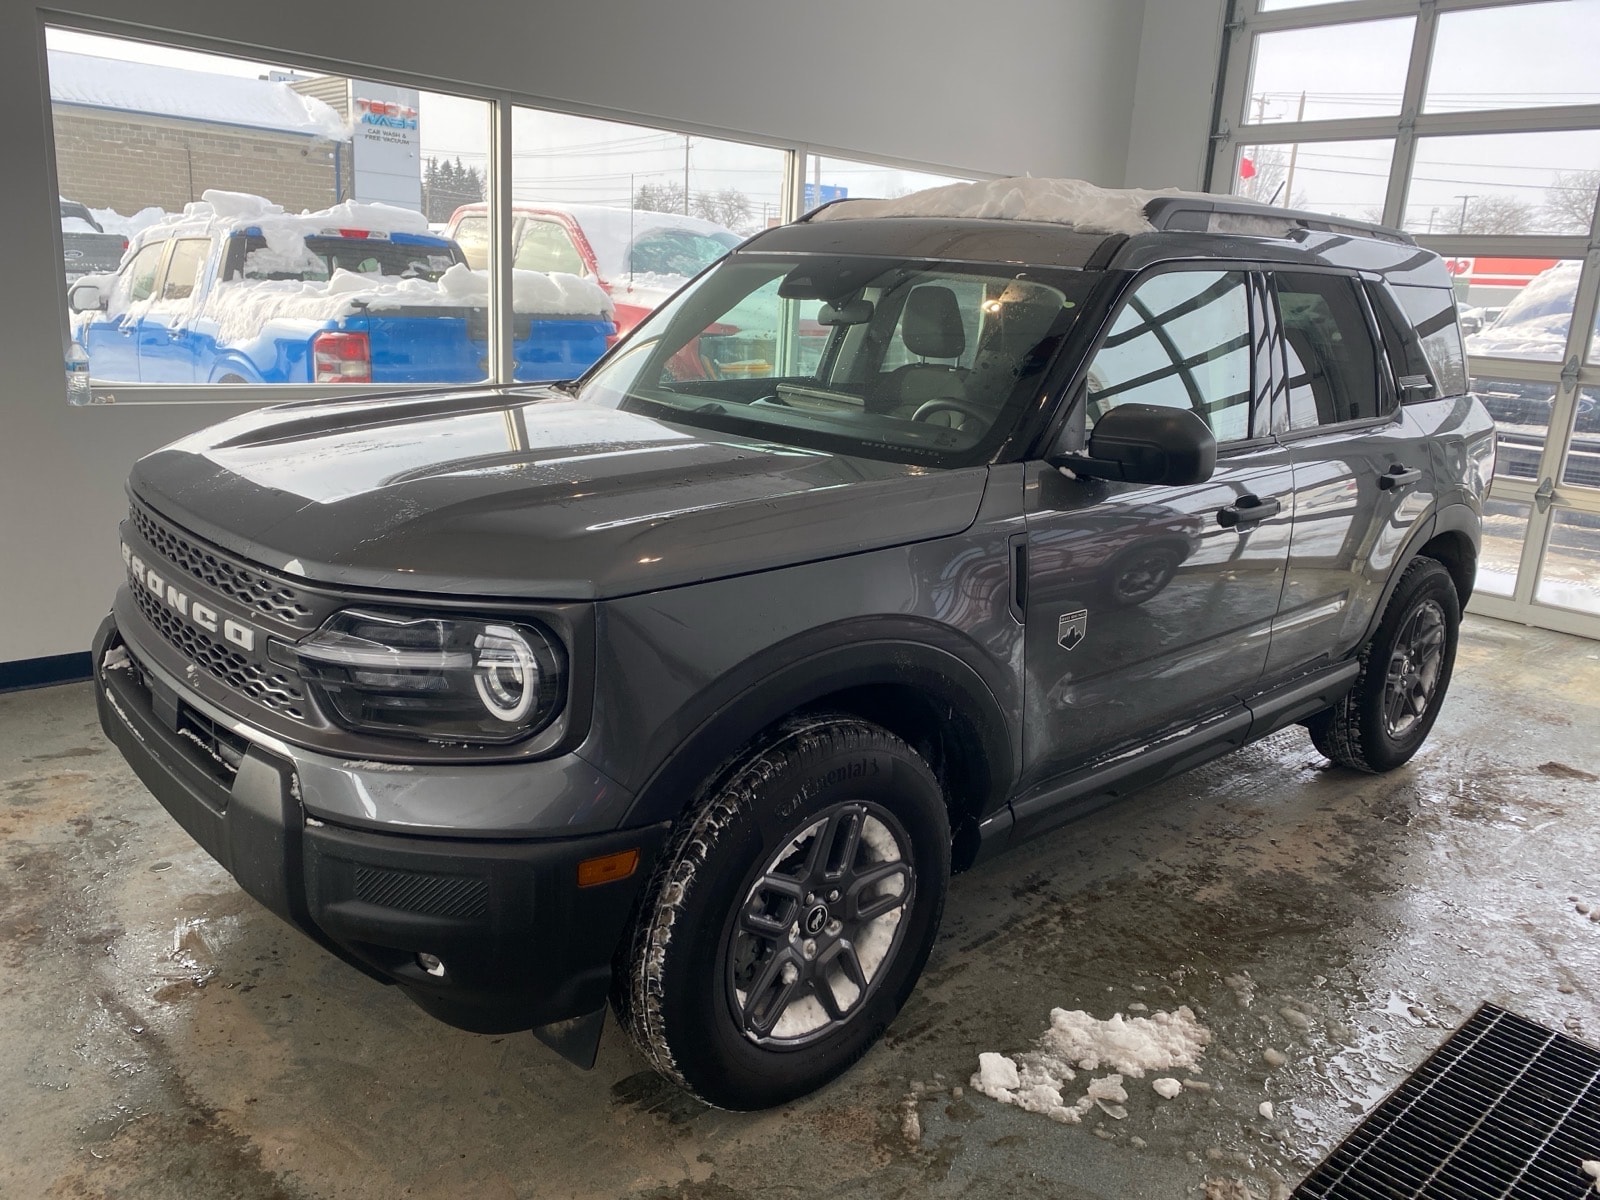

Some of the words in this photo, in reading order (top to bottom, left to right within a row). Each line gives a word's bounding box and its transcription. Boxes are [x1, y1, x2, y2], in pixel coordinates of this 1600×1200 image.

[382, 130, 401, 138] WASH
[383, 136, 410, 145] VACUUM
[121, 541, 255, 651] BRONCO
